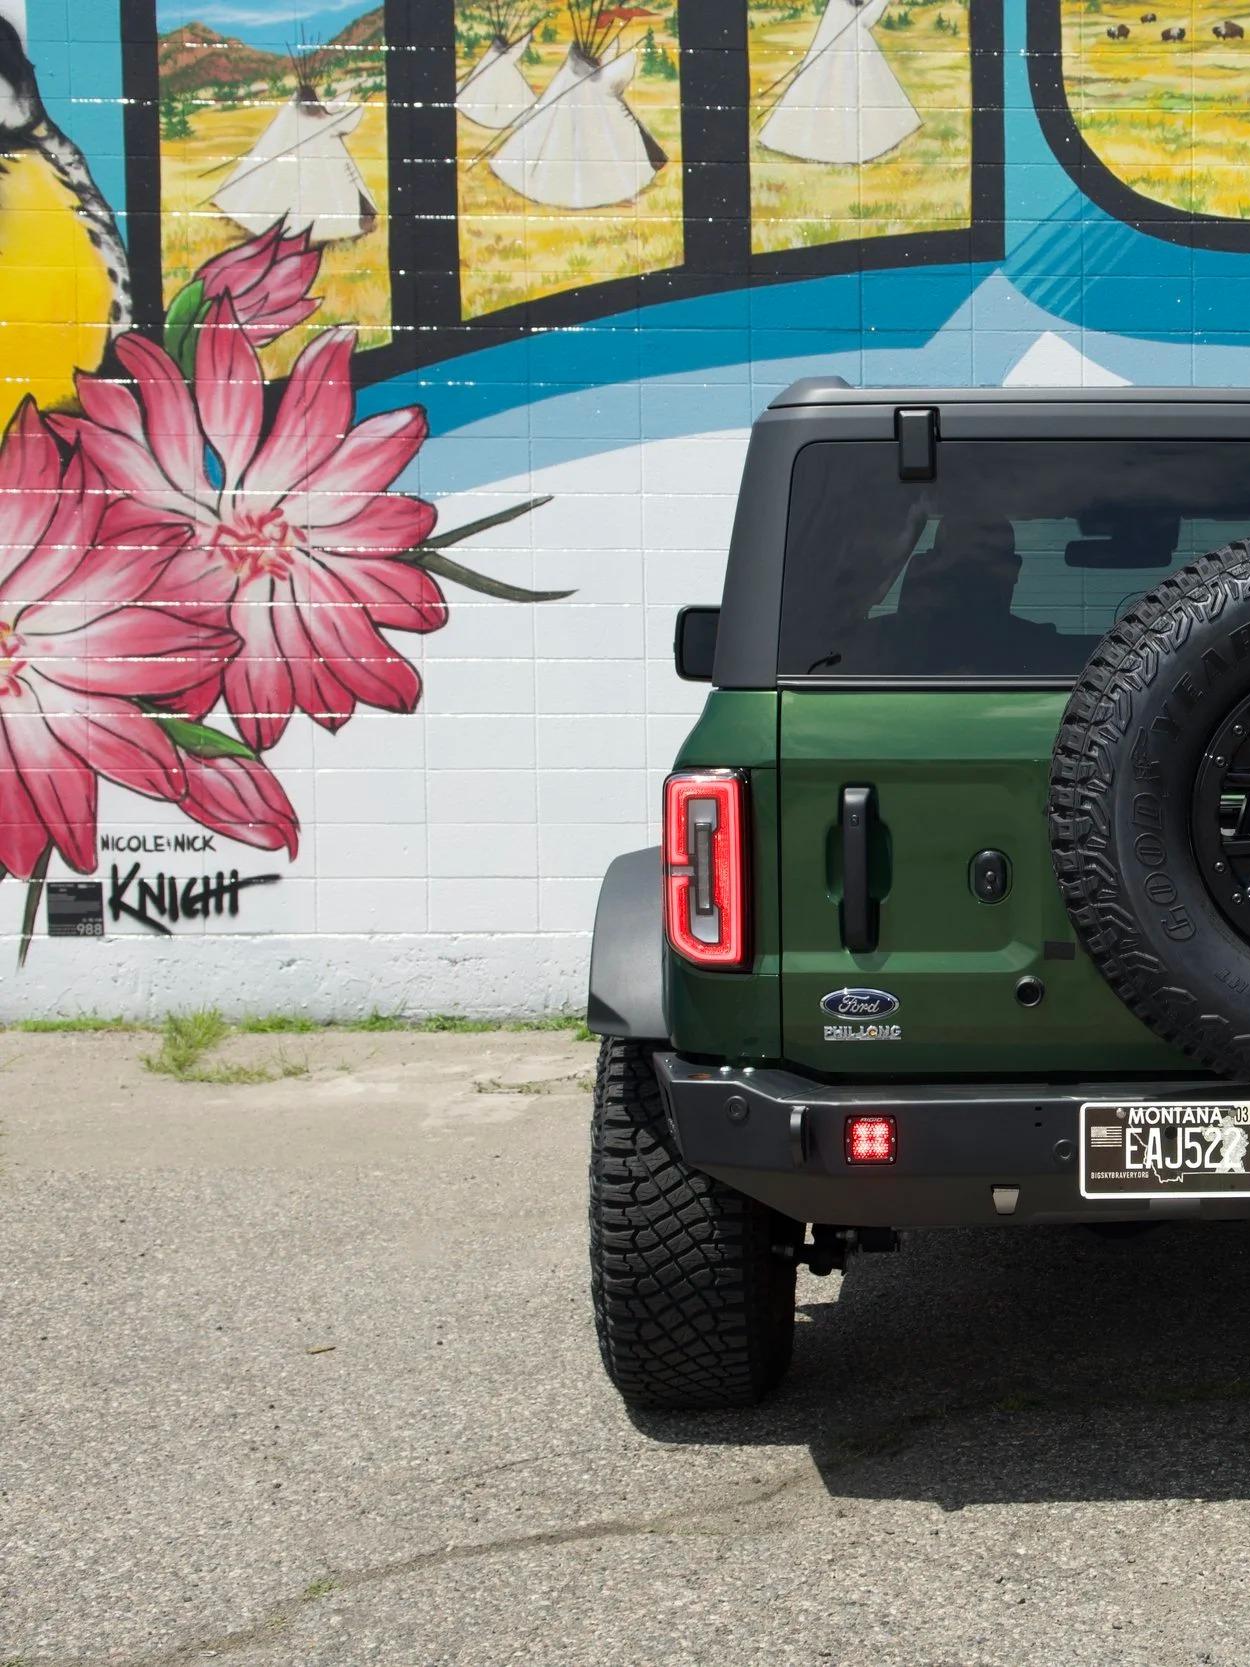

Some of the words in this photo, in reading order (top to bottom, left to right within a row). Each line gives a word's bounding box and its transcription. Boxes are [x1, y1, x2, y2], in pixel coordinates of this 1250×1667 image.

[101, 833, 165, 852] NICOLE
[174, 833, 216, 852] NICK
[108, 861, 282, 939] KNIGHT
[76, 923, 102, 936] 988
[838, 994, 881, 1013] Ford
[824, 1025, 856, 1039] PHIL
[860, 1025, 901, 1039] LONG
[1128, 1106, 1223, 1125] MONTANA
[1235, 1106, 1249, 1123] 03
[1125, 1126, 1242, 1170] EAJ522
